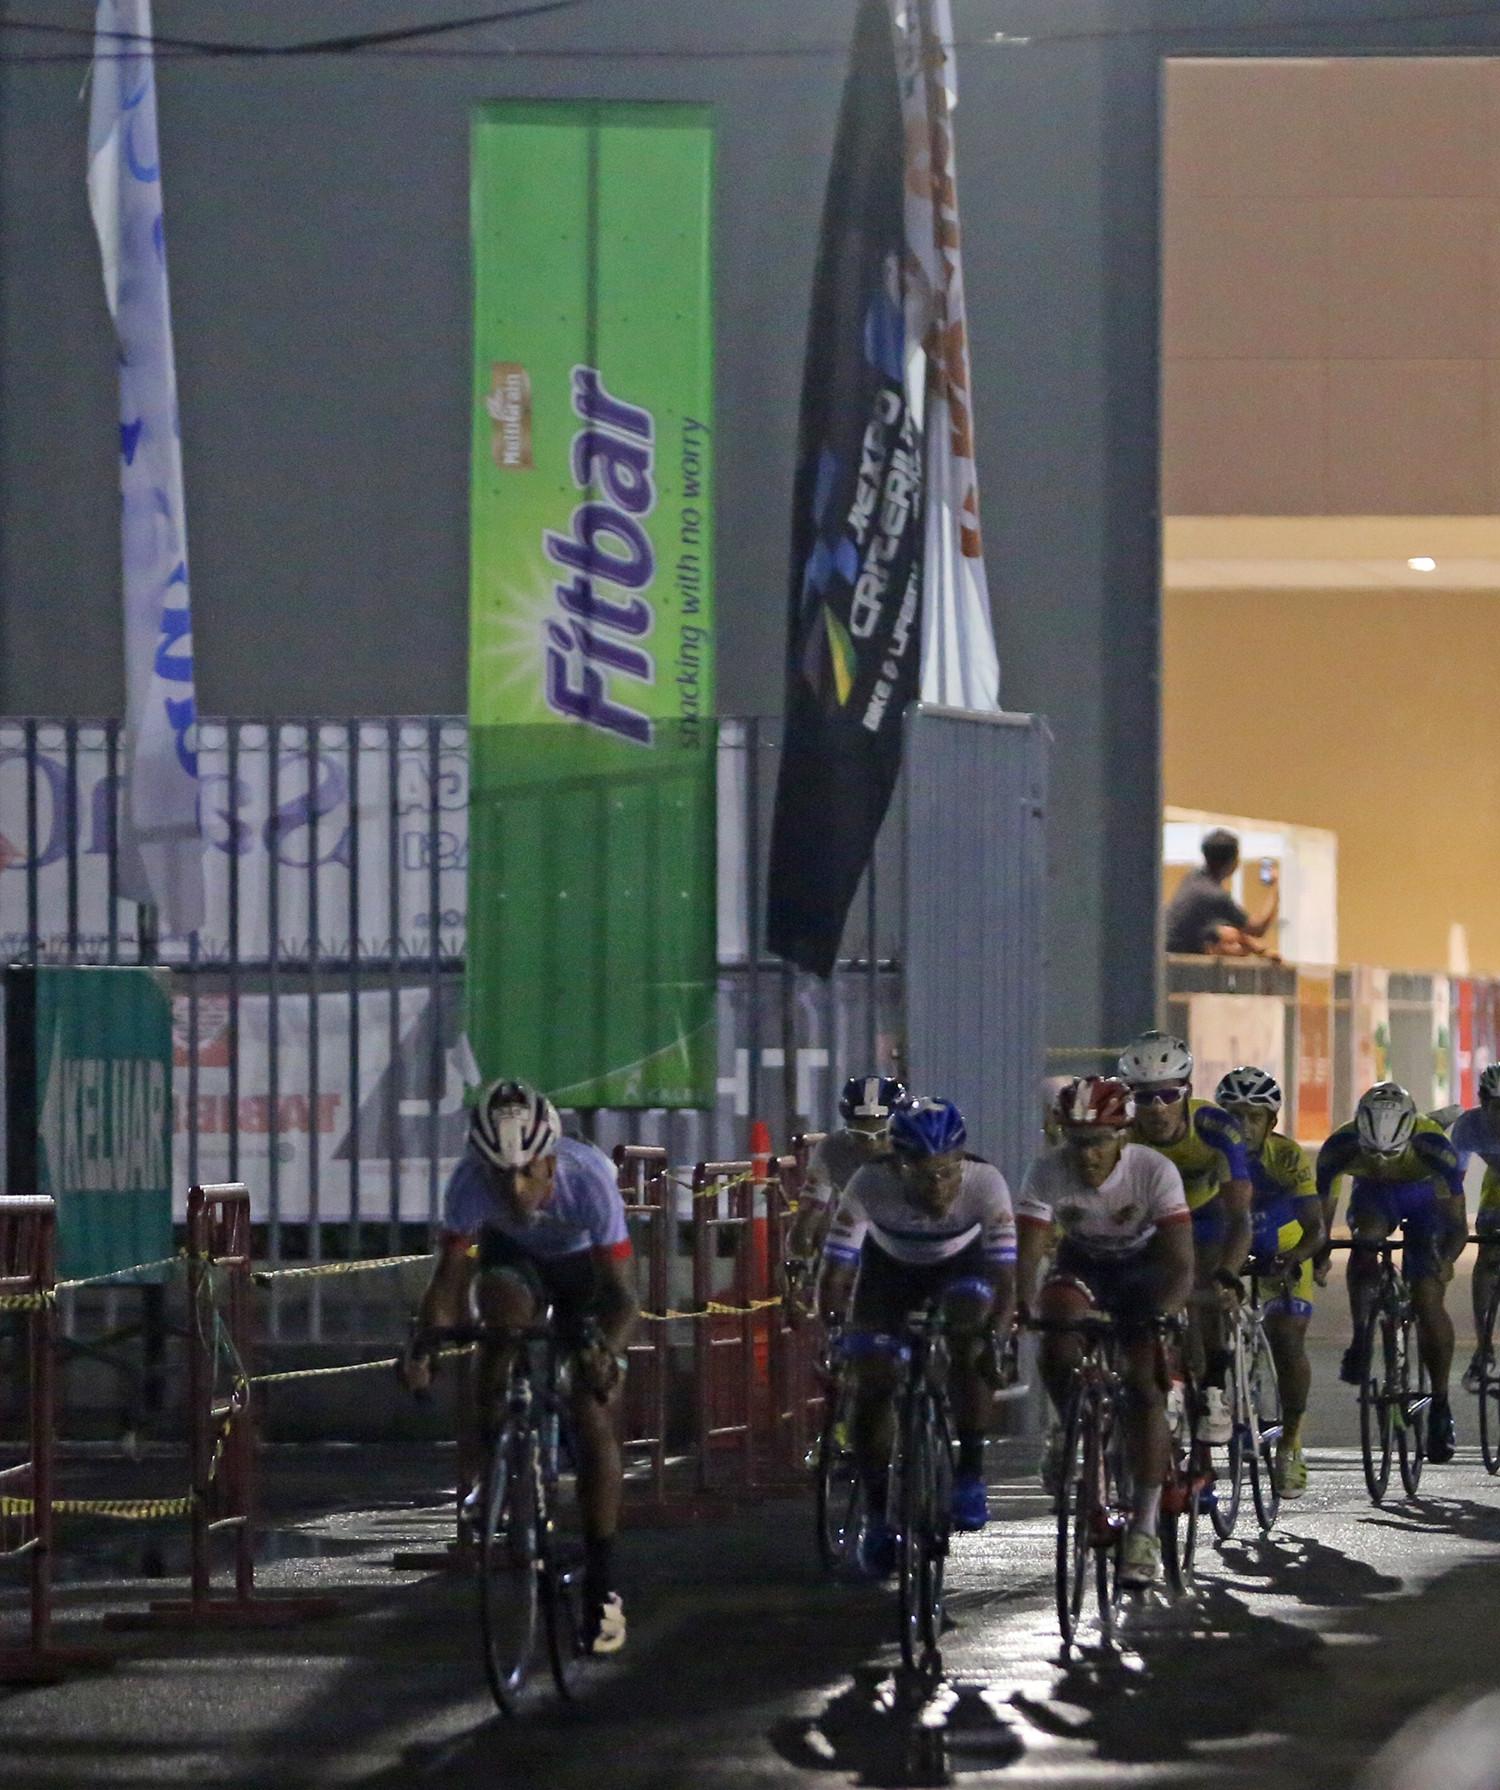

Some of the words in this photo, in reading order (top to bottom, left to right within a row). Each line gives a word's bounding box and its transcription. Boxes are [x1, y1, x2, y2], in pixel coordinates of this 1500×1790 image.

[682, 416, 709, 499] worry
[543, 364, 656, 748] Fitbar
[682, 507, 701, 548] no
[676, 565, 701, 620] with
[676, 624, 706, 750] snacking
[64, 1060, 167, 1191] KELUAR
